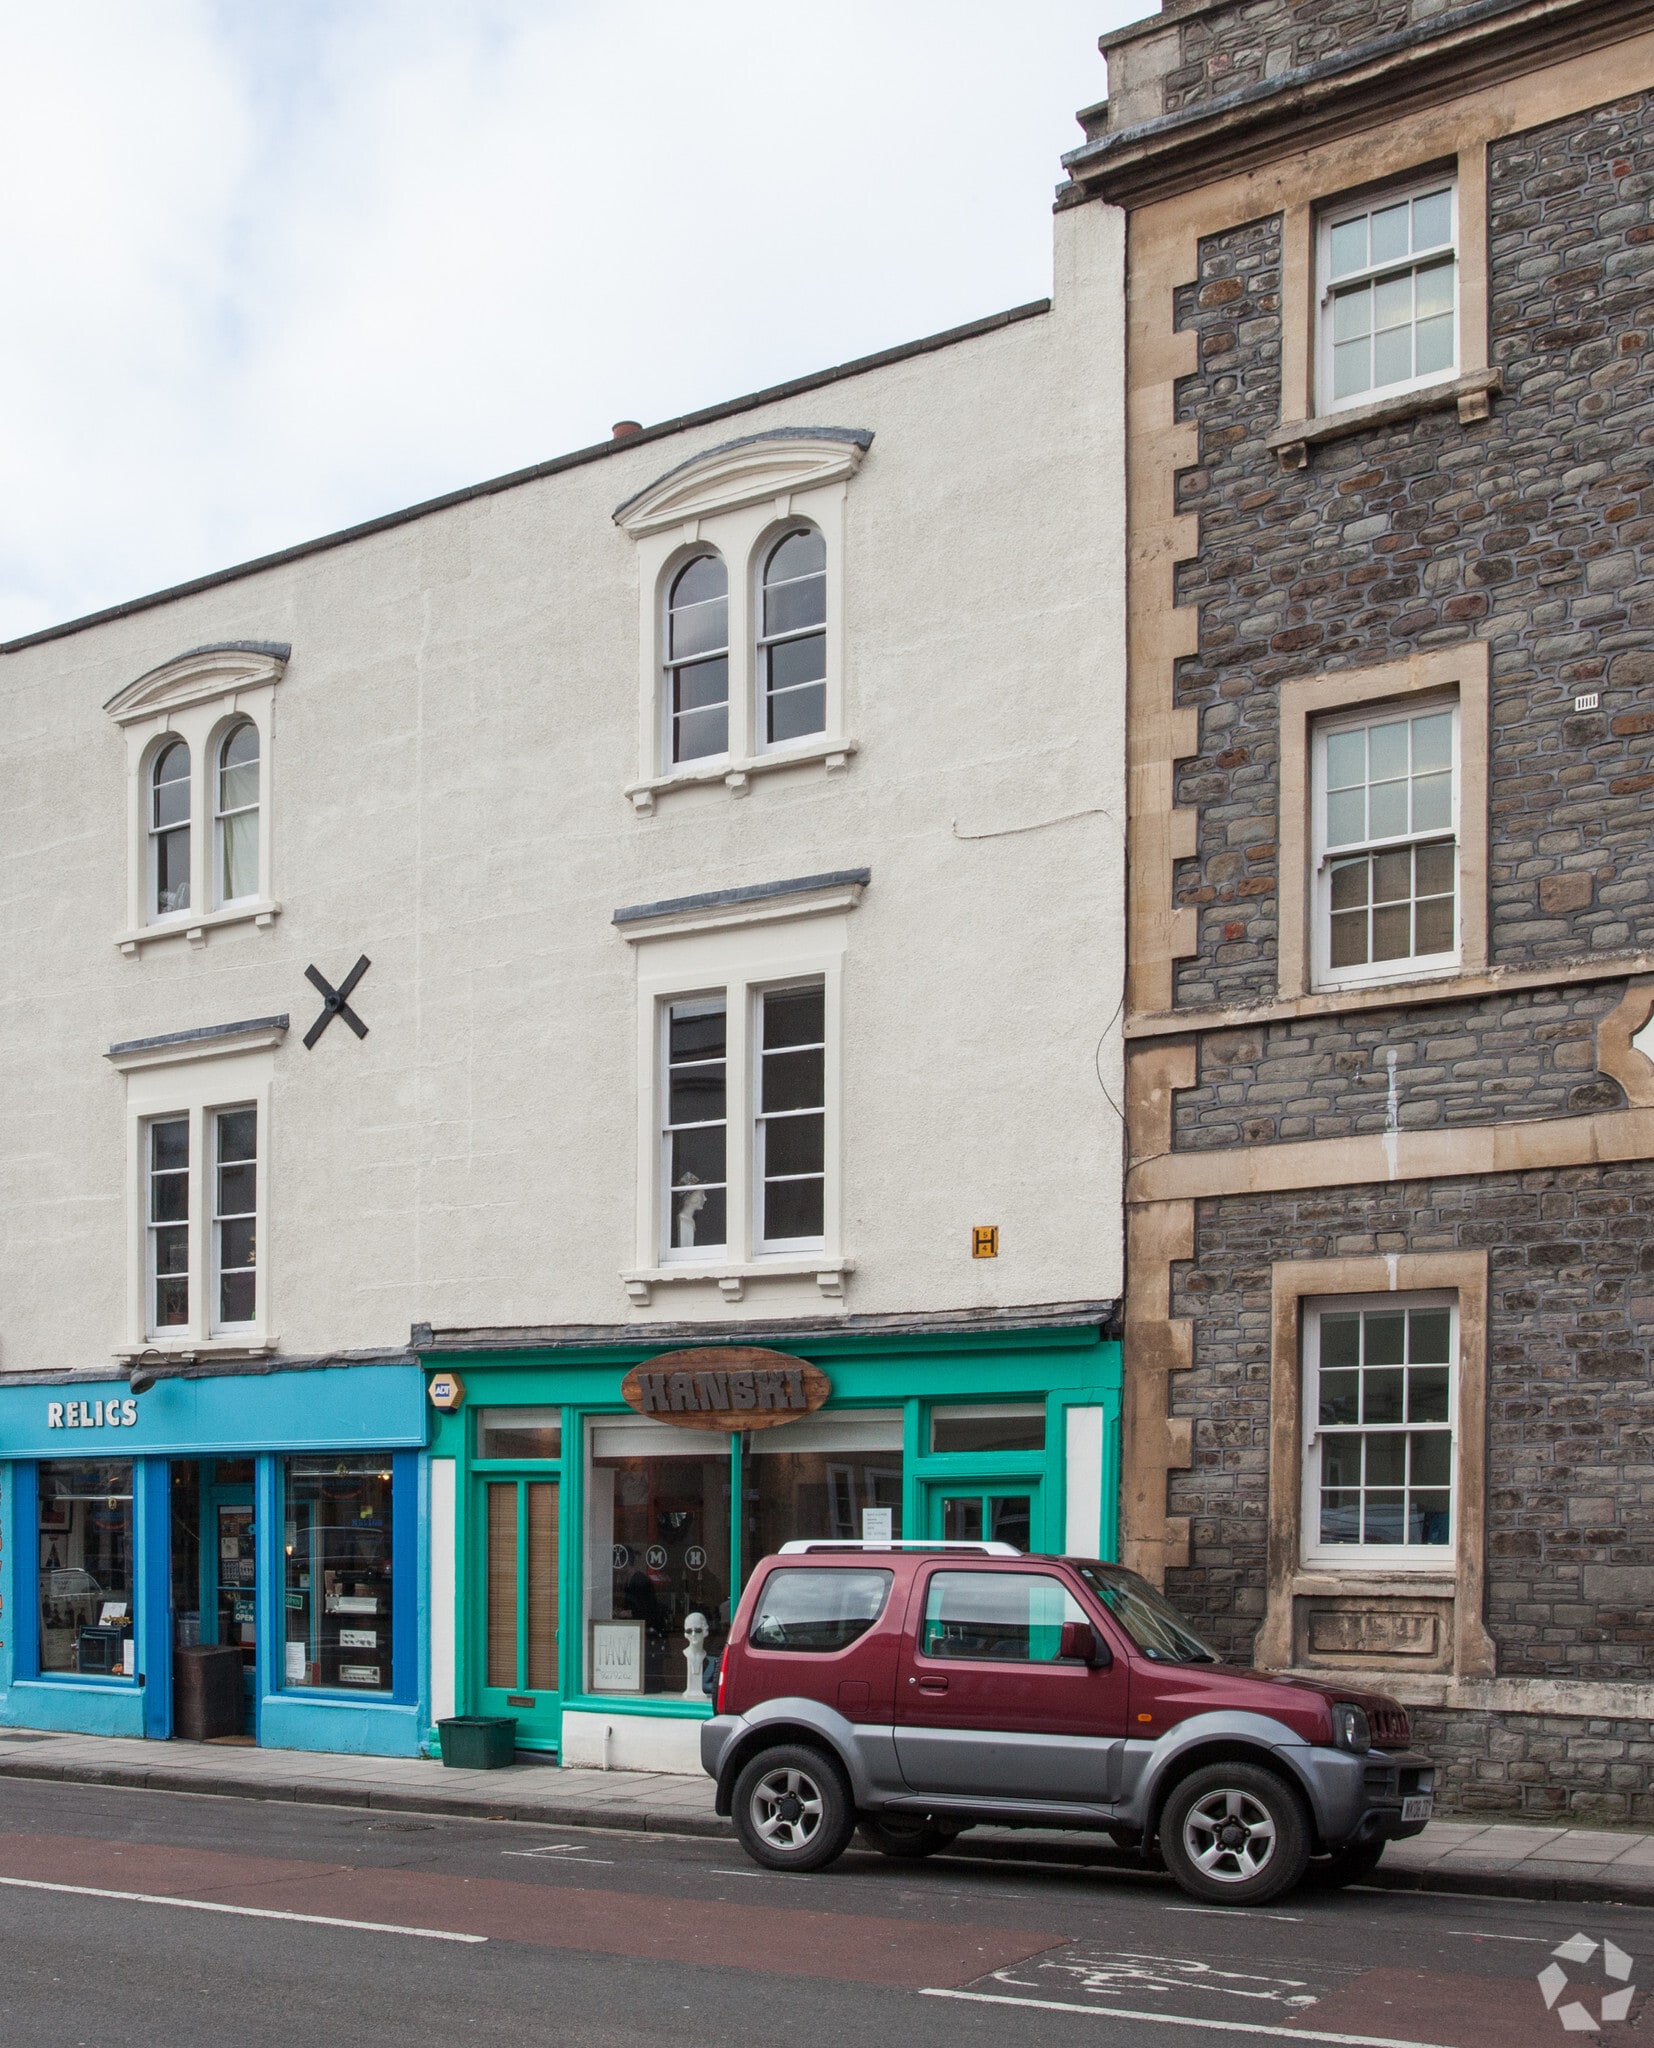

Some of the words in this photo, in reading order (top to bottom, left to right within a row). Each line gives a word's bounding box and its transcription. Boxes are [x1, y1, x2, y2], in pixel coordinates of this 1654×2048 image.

[976, 1229, 994, 1254] H
[435, 1385, 451, 1396] ADT
[637, 1369, 807, 1411] HANSKI
[47, 1399, 138, 1428] RELICS
[650, 1551, 663, 1564] M
[690, 1551, 701, 1565] H
[235, 1614, 254, 1622] OPEN
